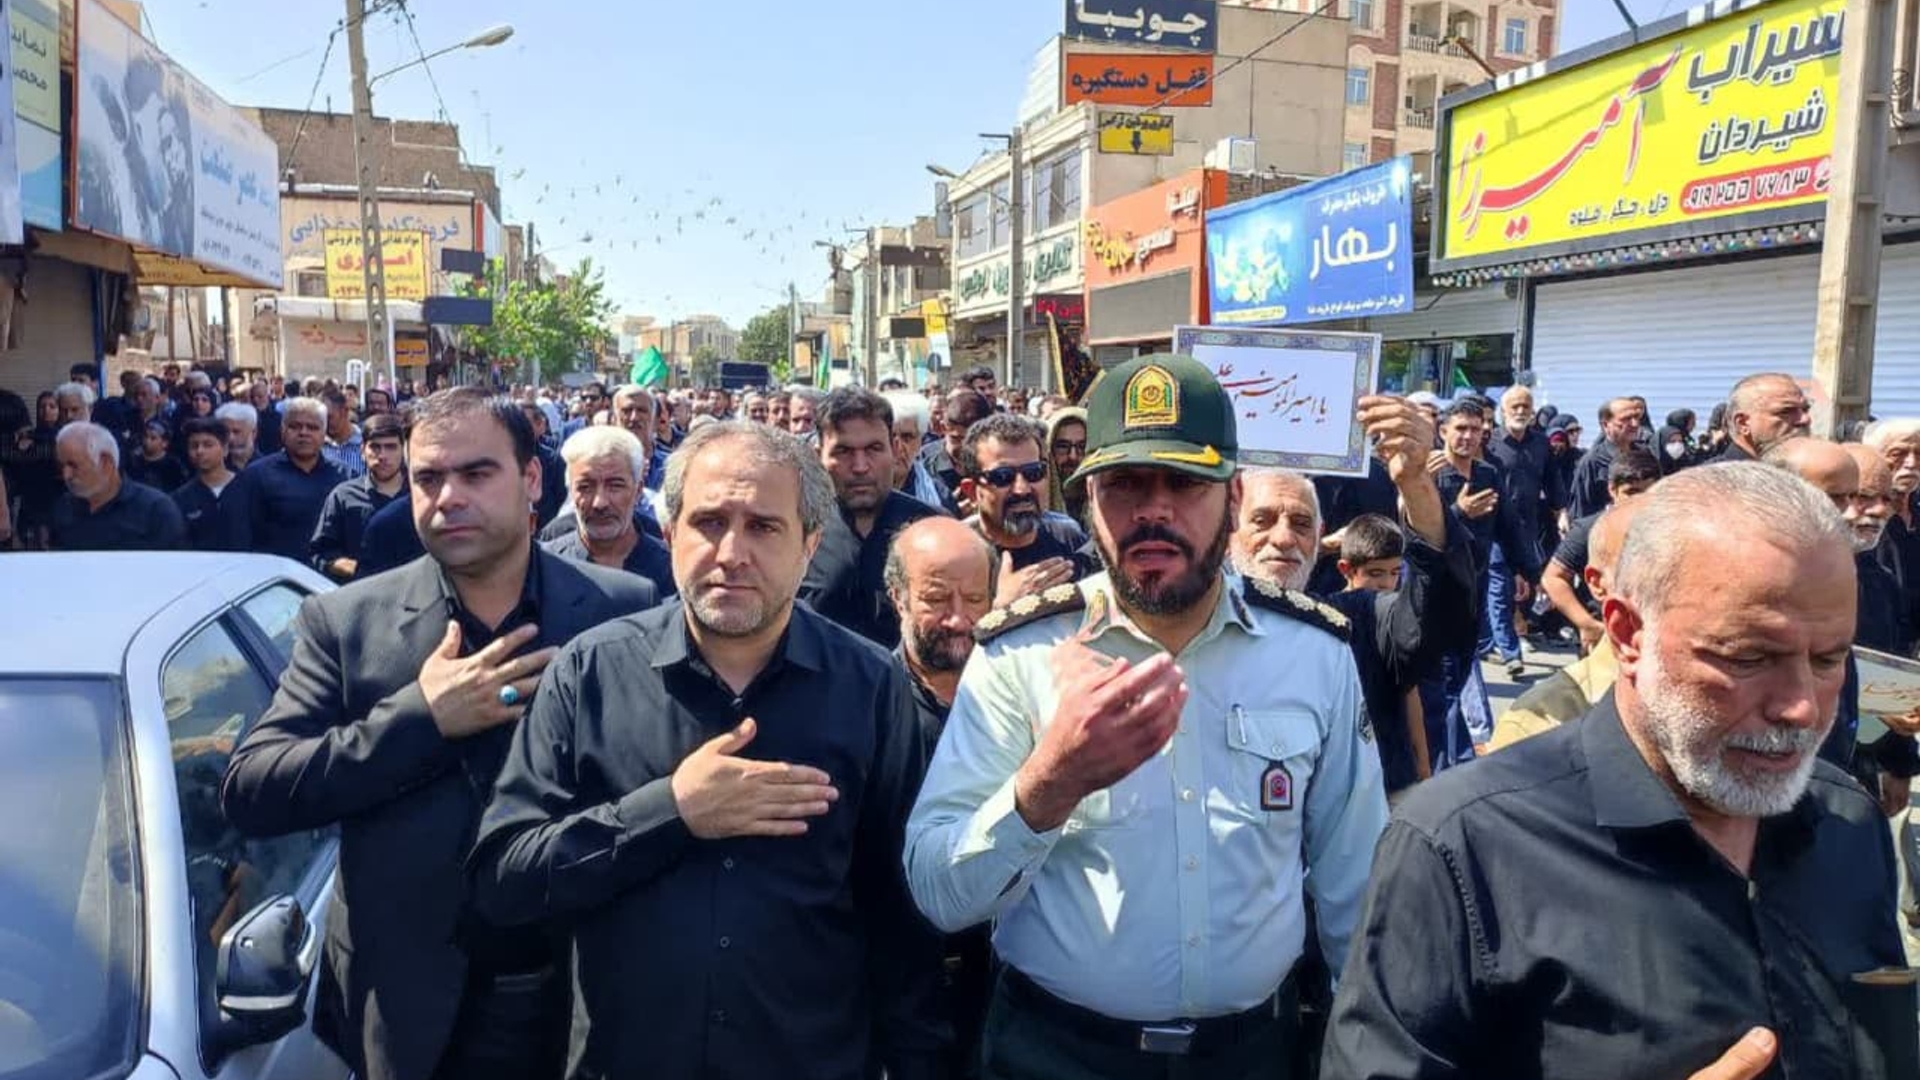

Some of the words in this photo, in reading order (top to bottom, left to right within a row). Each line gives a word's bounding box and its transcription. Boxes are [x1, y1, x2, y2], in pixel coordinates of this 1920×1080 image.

[1072, 67, 1149, 94] دستگیره
[1156, 67, 1207, 93] قفل
[1699, 89, 1825, 161] شیردان
[1648, 193, 1668, 215] دل
[1309, 221, 1398, 281] بهار
